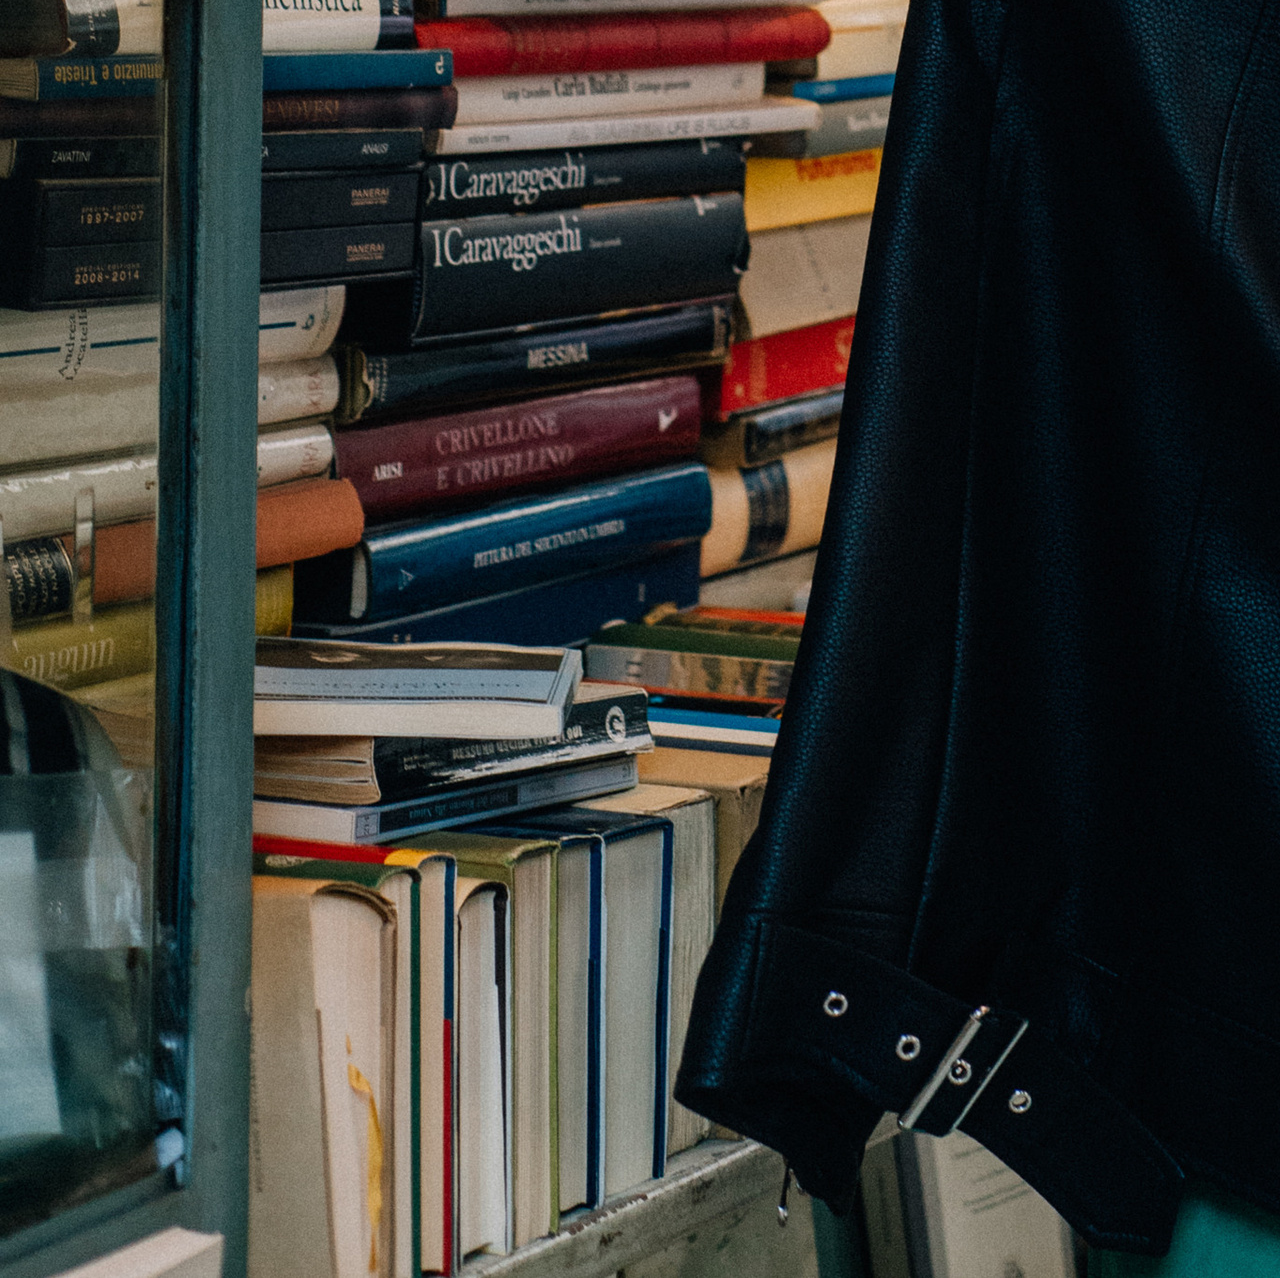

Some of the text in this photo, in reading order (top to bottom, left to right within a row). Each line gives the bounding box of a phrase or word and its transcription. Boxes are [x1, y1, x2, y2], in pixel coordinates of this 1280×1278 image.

[54, 64, 98, 86] Trieste
[51, 150, 91, 164] ZAVATTINI
[449, 152, 586, 206] Caravaggeschi
[80, 210, 145, 225] 1997-2007
[444, 214, 582, 272] Caravaggeschi
[58, 313, 76, 377] Andrea
[527, 341, 590, 370] MESSINA
[435, 410, 560, 456] CRIVELLONE
[437, 444, 576, 491] E CRIVELLINO
